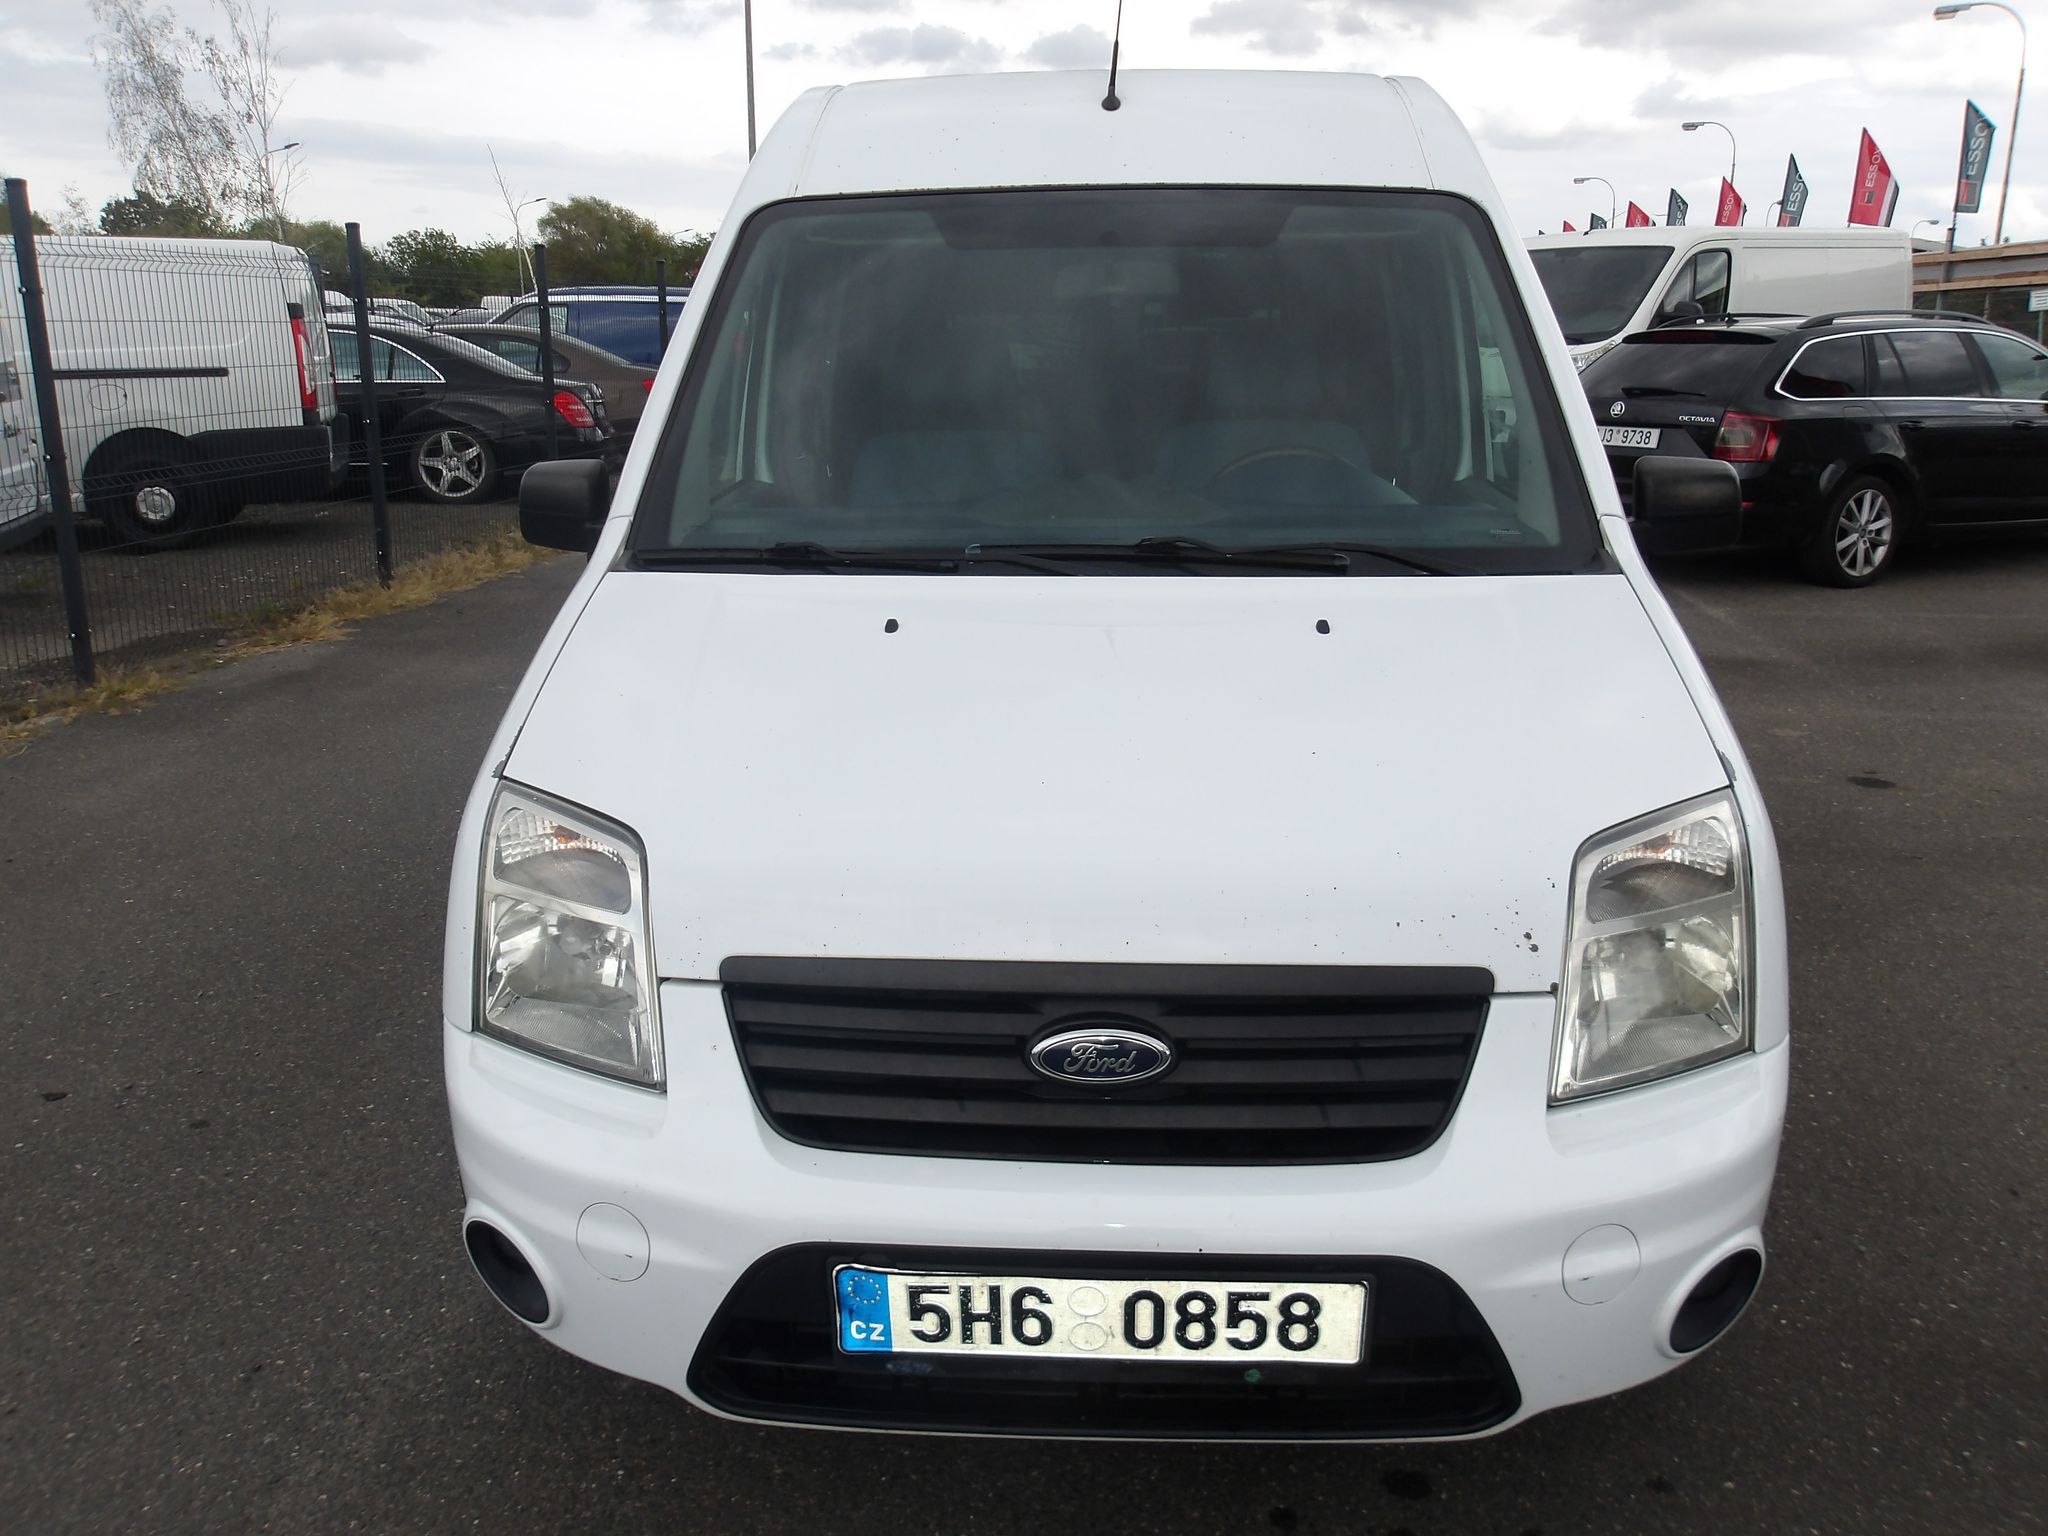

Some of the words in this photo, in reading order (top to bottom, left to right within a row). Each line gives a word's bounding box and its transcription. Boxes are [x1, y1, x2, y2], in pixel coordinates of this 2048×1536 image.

[1679, 415, 1715, 423] OCTAVIA
[1598, 428, 1614, 443] J3
[1621, 429, 1652, 445] 9738
[1064, 1042, 1137, 1073] Ford
[907, 1284, 1054, 1346] 5H6
[1123, 1289, 1321, 1351] 0858
[851, 1320, 885, 1341] CZ
